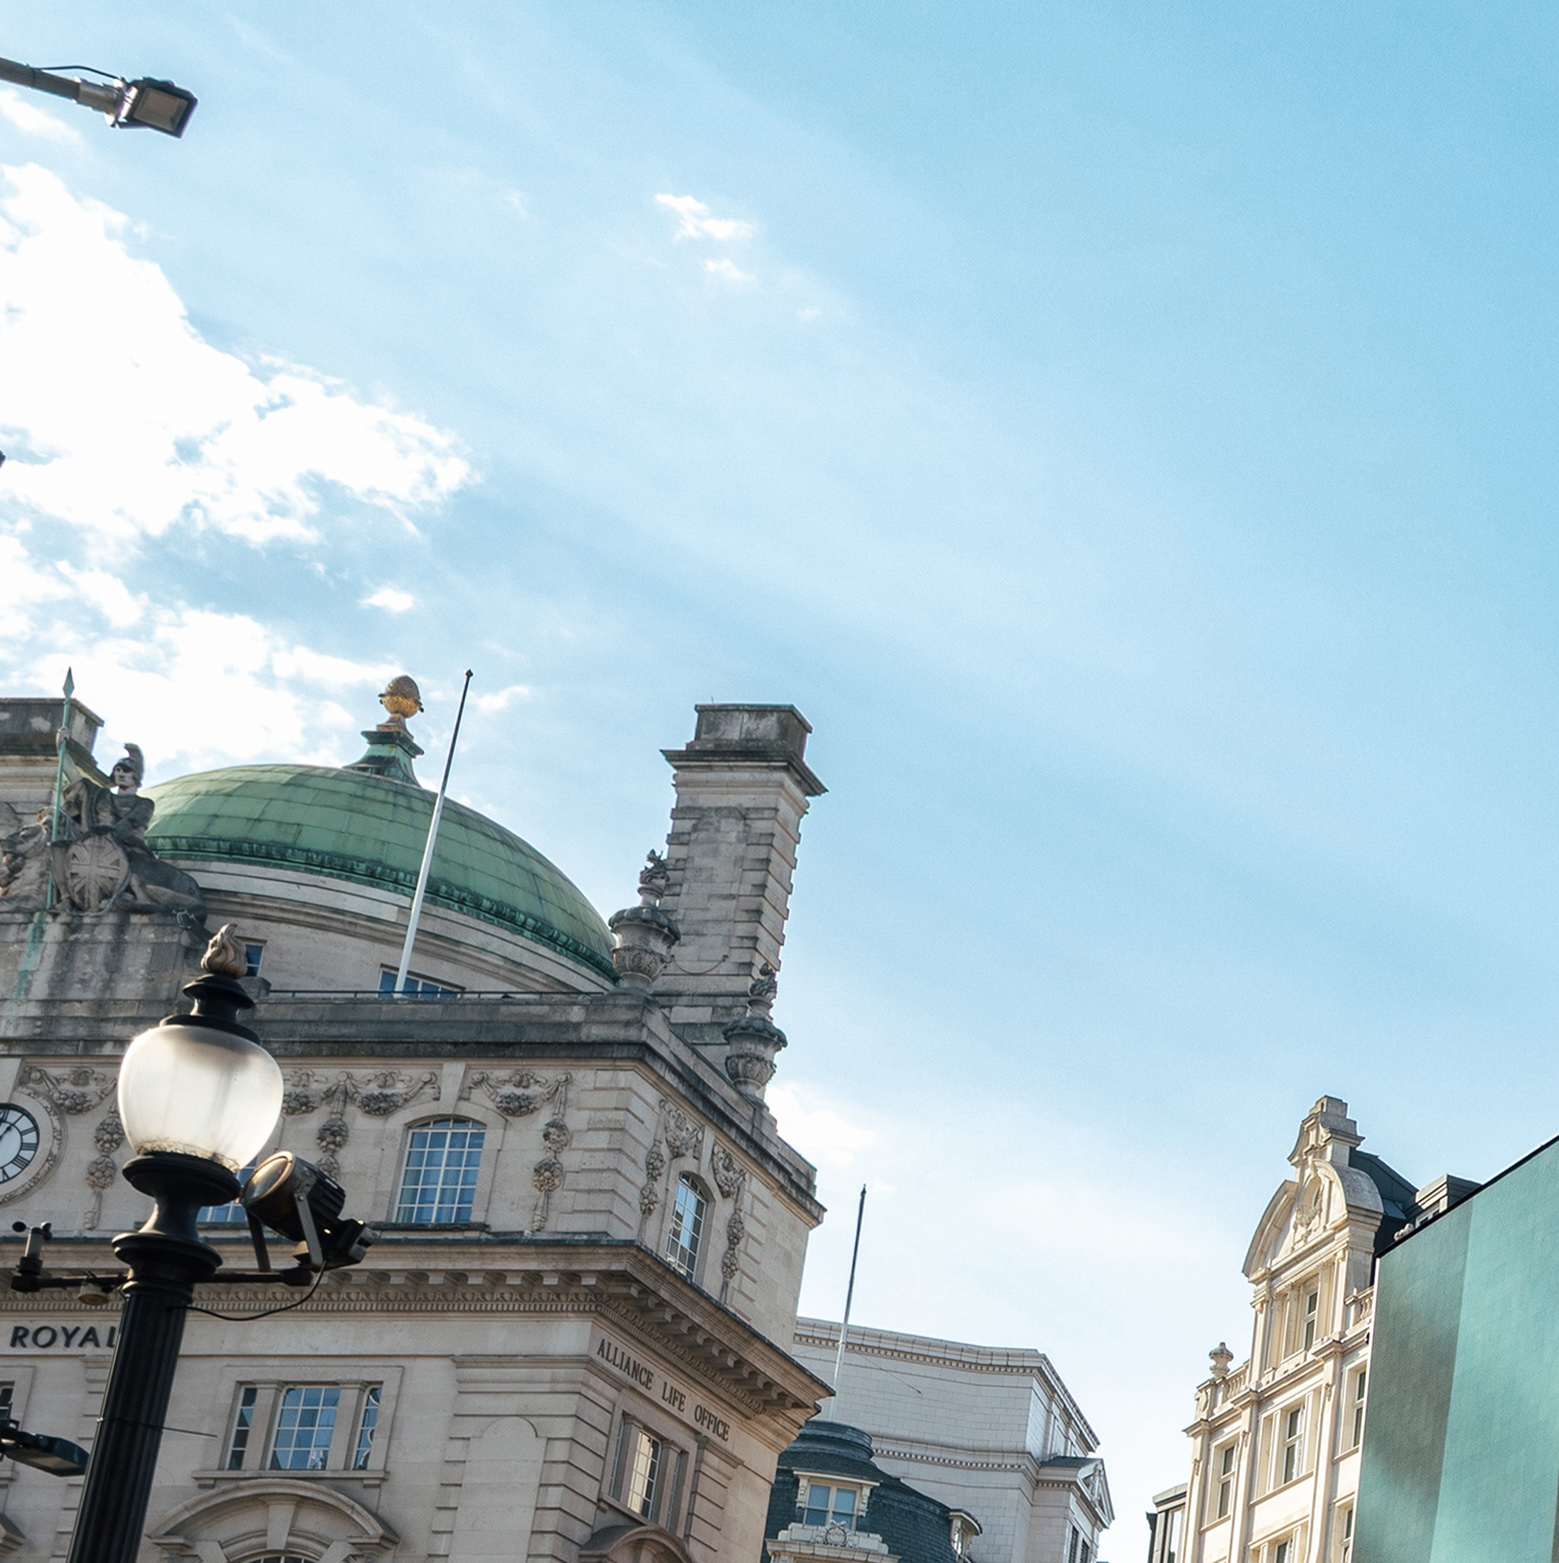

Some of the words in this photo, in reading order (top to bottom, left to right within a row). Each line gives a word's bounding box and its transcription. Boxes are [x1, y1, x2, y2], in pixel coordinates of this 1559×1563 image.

[10, 1326, 117, 1348] ROYAL
[597, 1338, 654, 1391] ALLIANCE
[661, 1381, 687, 1412] LIFE
[694, 1404, 730, 1442] OFFICE
